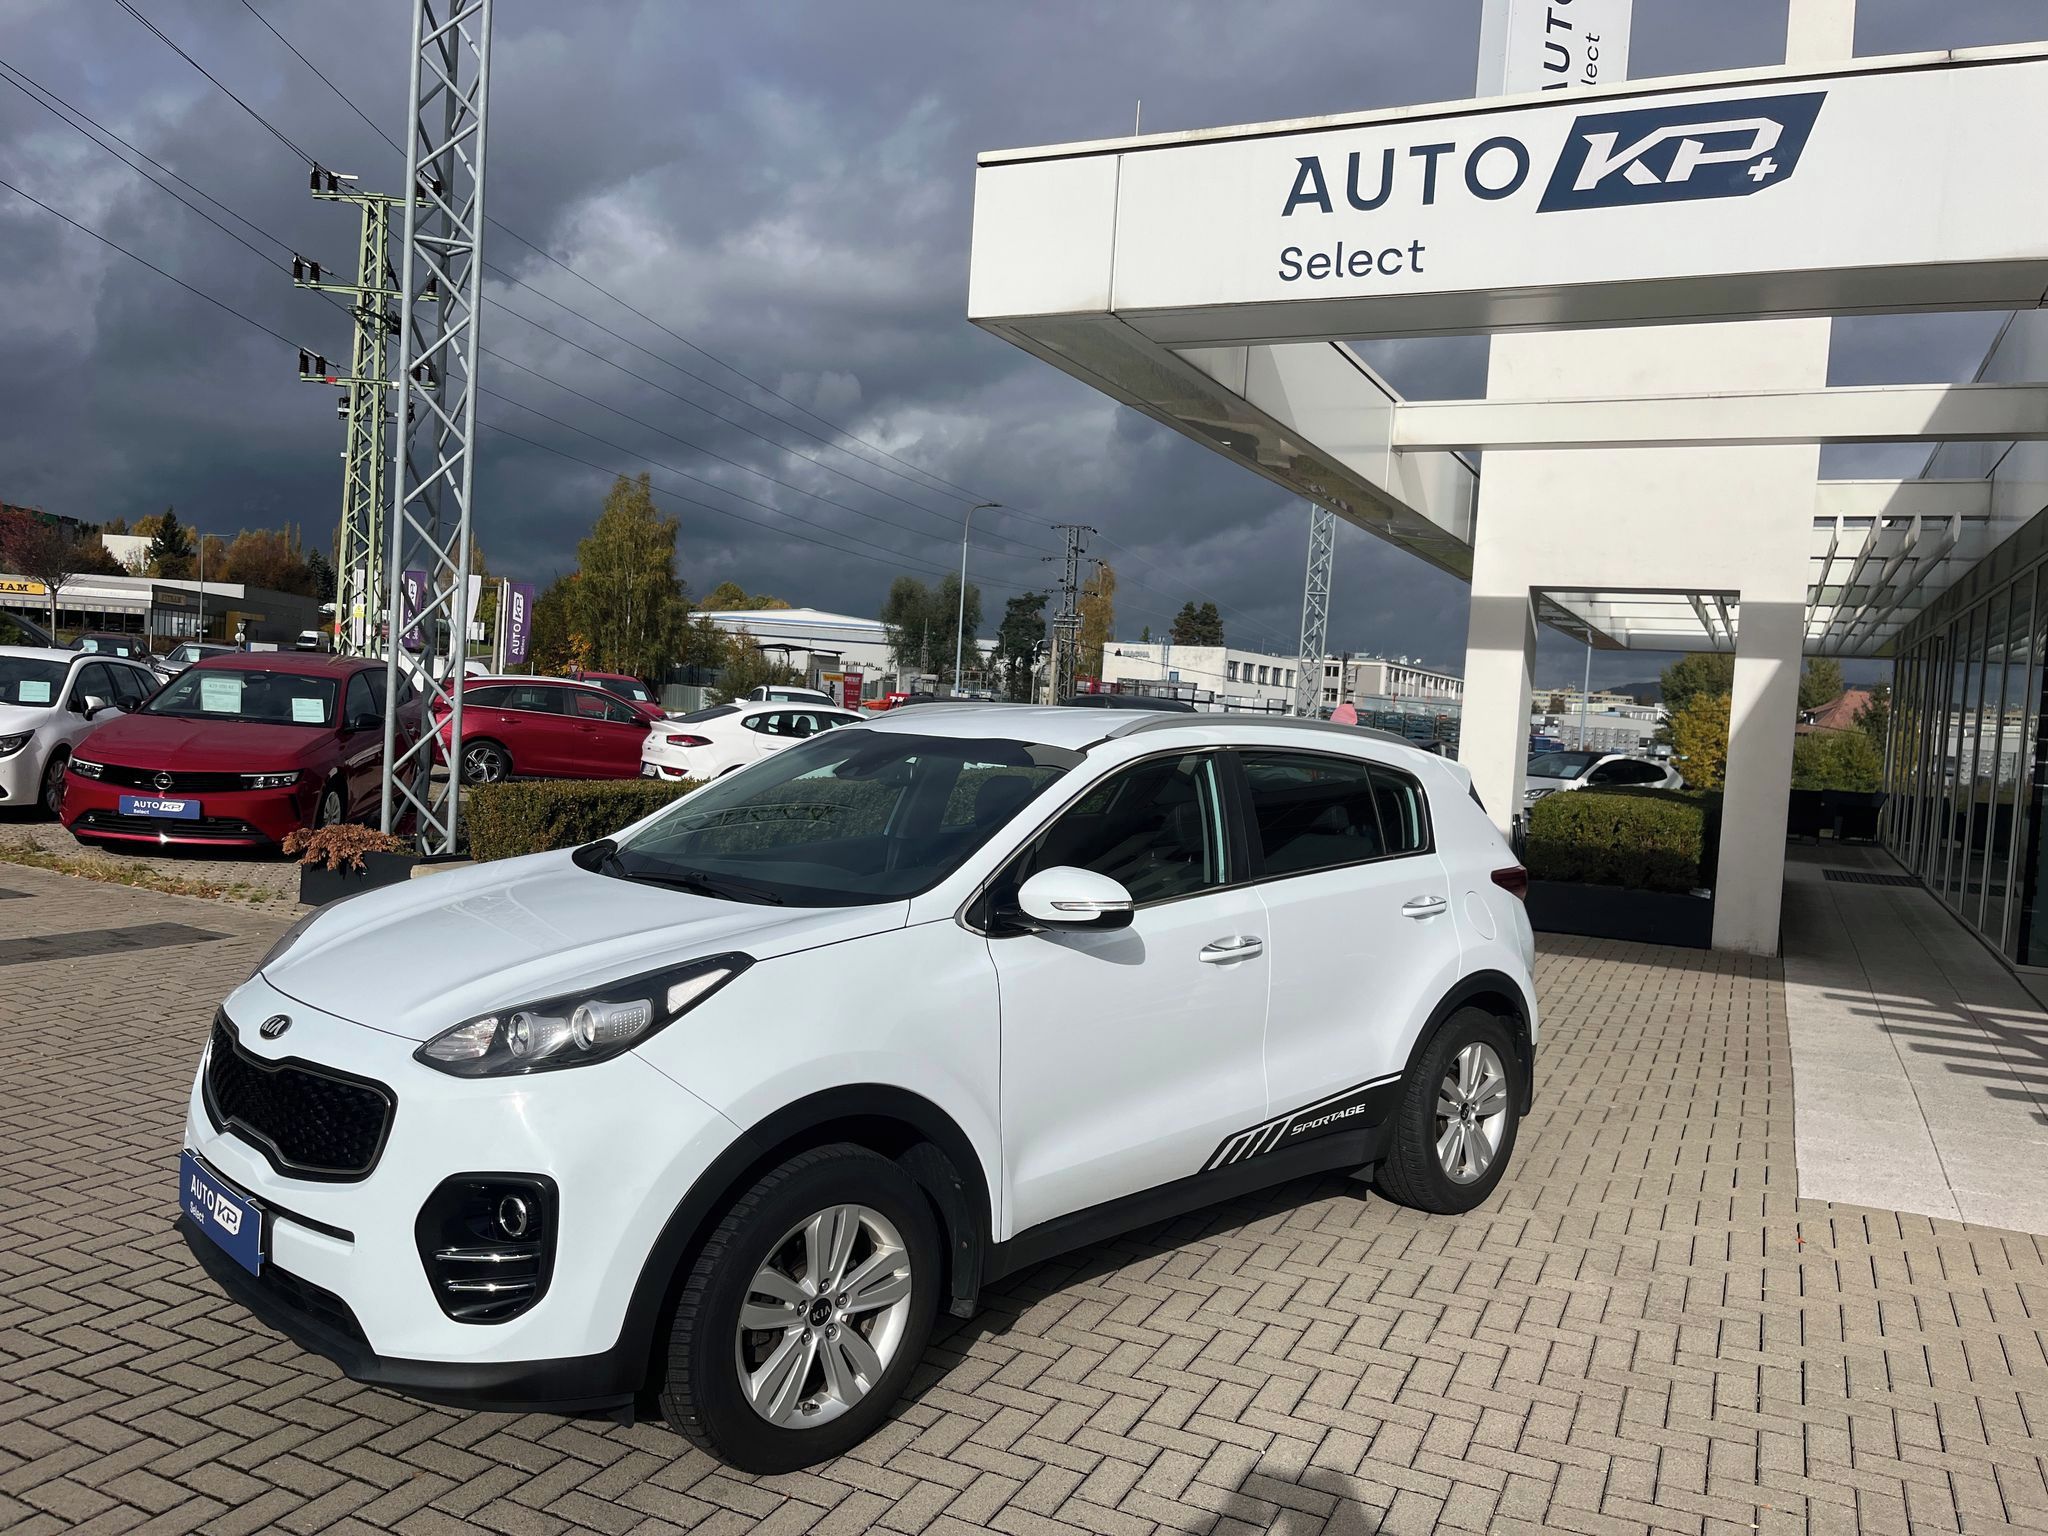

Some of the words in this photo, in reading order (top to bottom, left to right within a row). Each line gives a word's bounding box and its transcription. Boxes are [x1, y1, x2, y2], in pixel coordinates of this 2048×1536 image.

[1541, 0, 1573, 90] UT
[1580, 32, 1601, 85] lect
[1281, 136, 1530, 216] AUTO
[1278, 240, 1425, 281] Select
[512, 623, 522, 655] AUTO
[133, 800, 160, 809] AUTO
[261, 1016, 286, 1036] KIA
[1290, 1103, 1366, 1136] SPORTAGE
[190, 1174, 215, 1211] AUTO
[189, 1201, 205, 1224] Select
[812, 1305, 831, 1321] KIA
